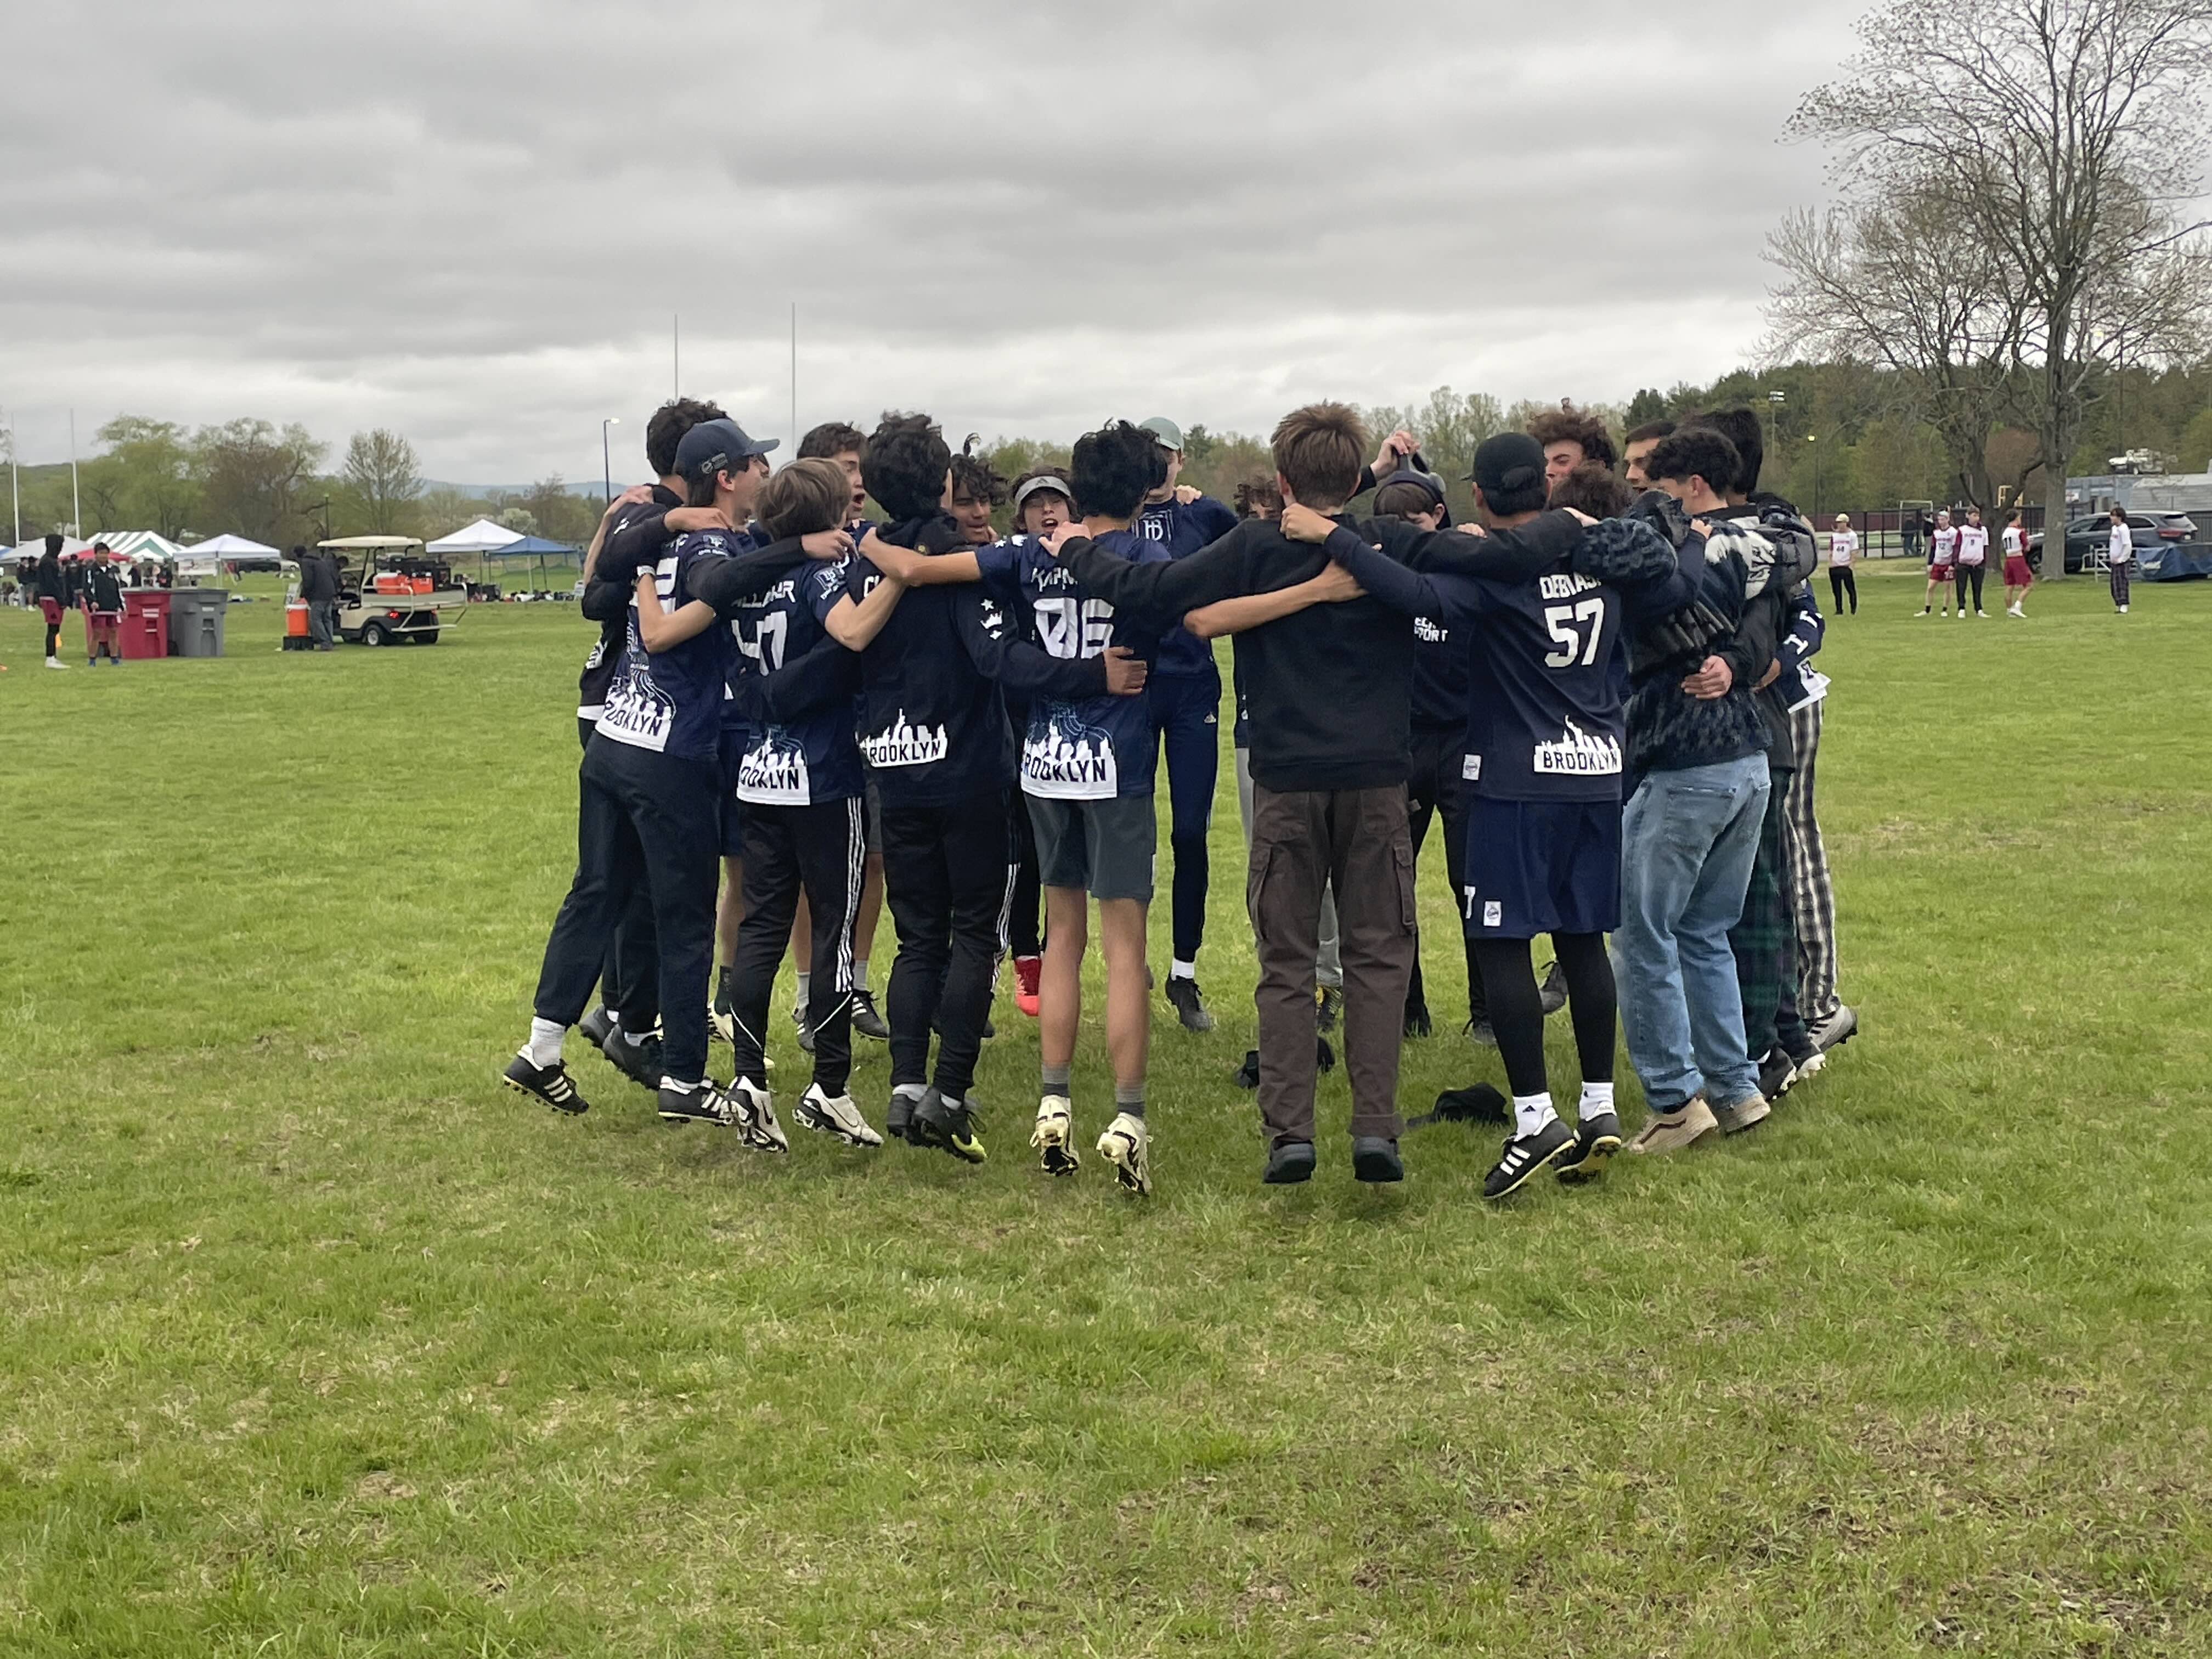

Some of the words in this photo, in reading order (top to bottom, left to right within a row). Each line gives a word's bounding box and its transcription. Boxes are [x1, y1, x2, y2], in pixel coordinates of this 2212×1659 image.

[1544, 597, 1604, 667] 57
[864, 742, 940, 763] ROOKLYN
[1544, 750, 1618, 771] BROOKLYN
[1021, 753, 1107, 782] ROOKLYN
